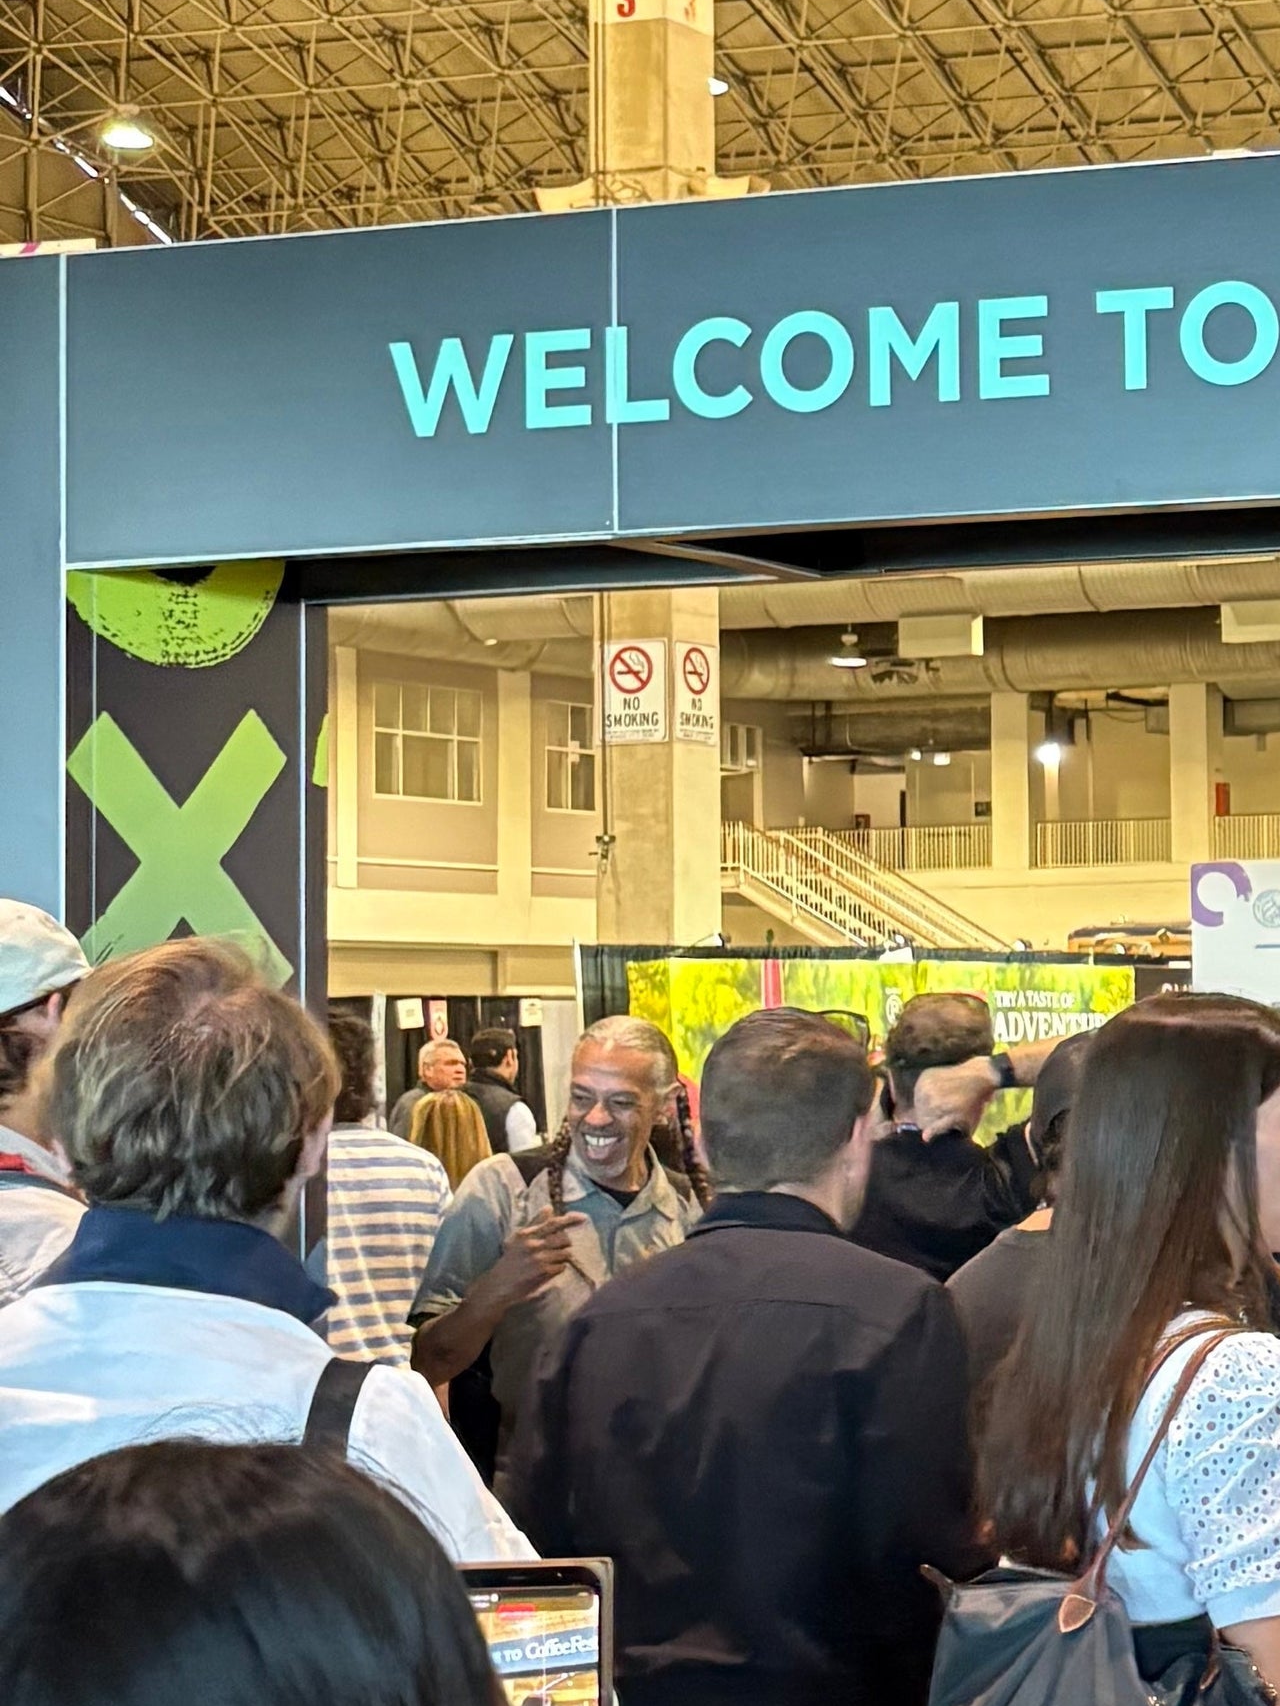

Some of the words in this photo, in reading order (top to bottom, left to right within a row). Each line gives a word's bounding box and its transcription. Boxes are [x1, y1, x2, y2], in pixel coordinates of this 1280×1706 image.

[389, 295, 1050, 437] WELCOME
[1096, 280, 1280, 391] TO
[623, 696, 641, 711] NO
[606, 711, 659, 728] SMOKING
[994, 1011, 1108, 1043] ADVENTUR
